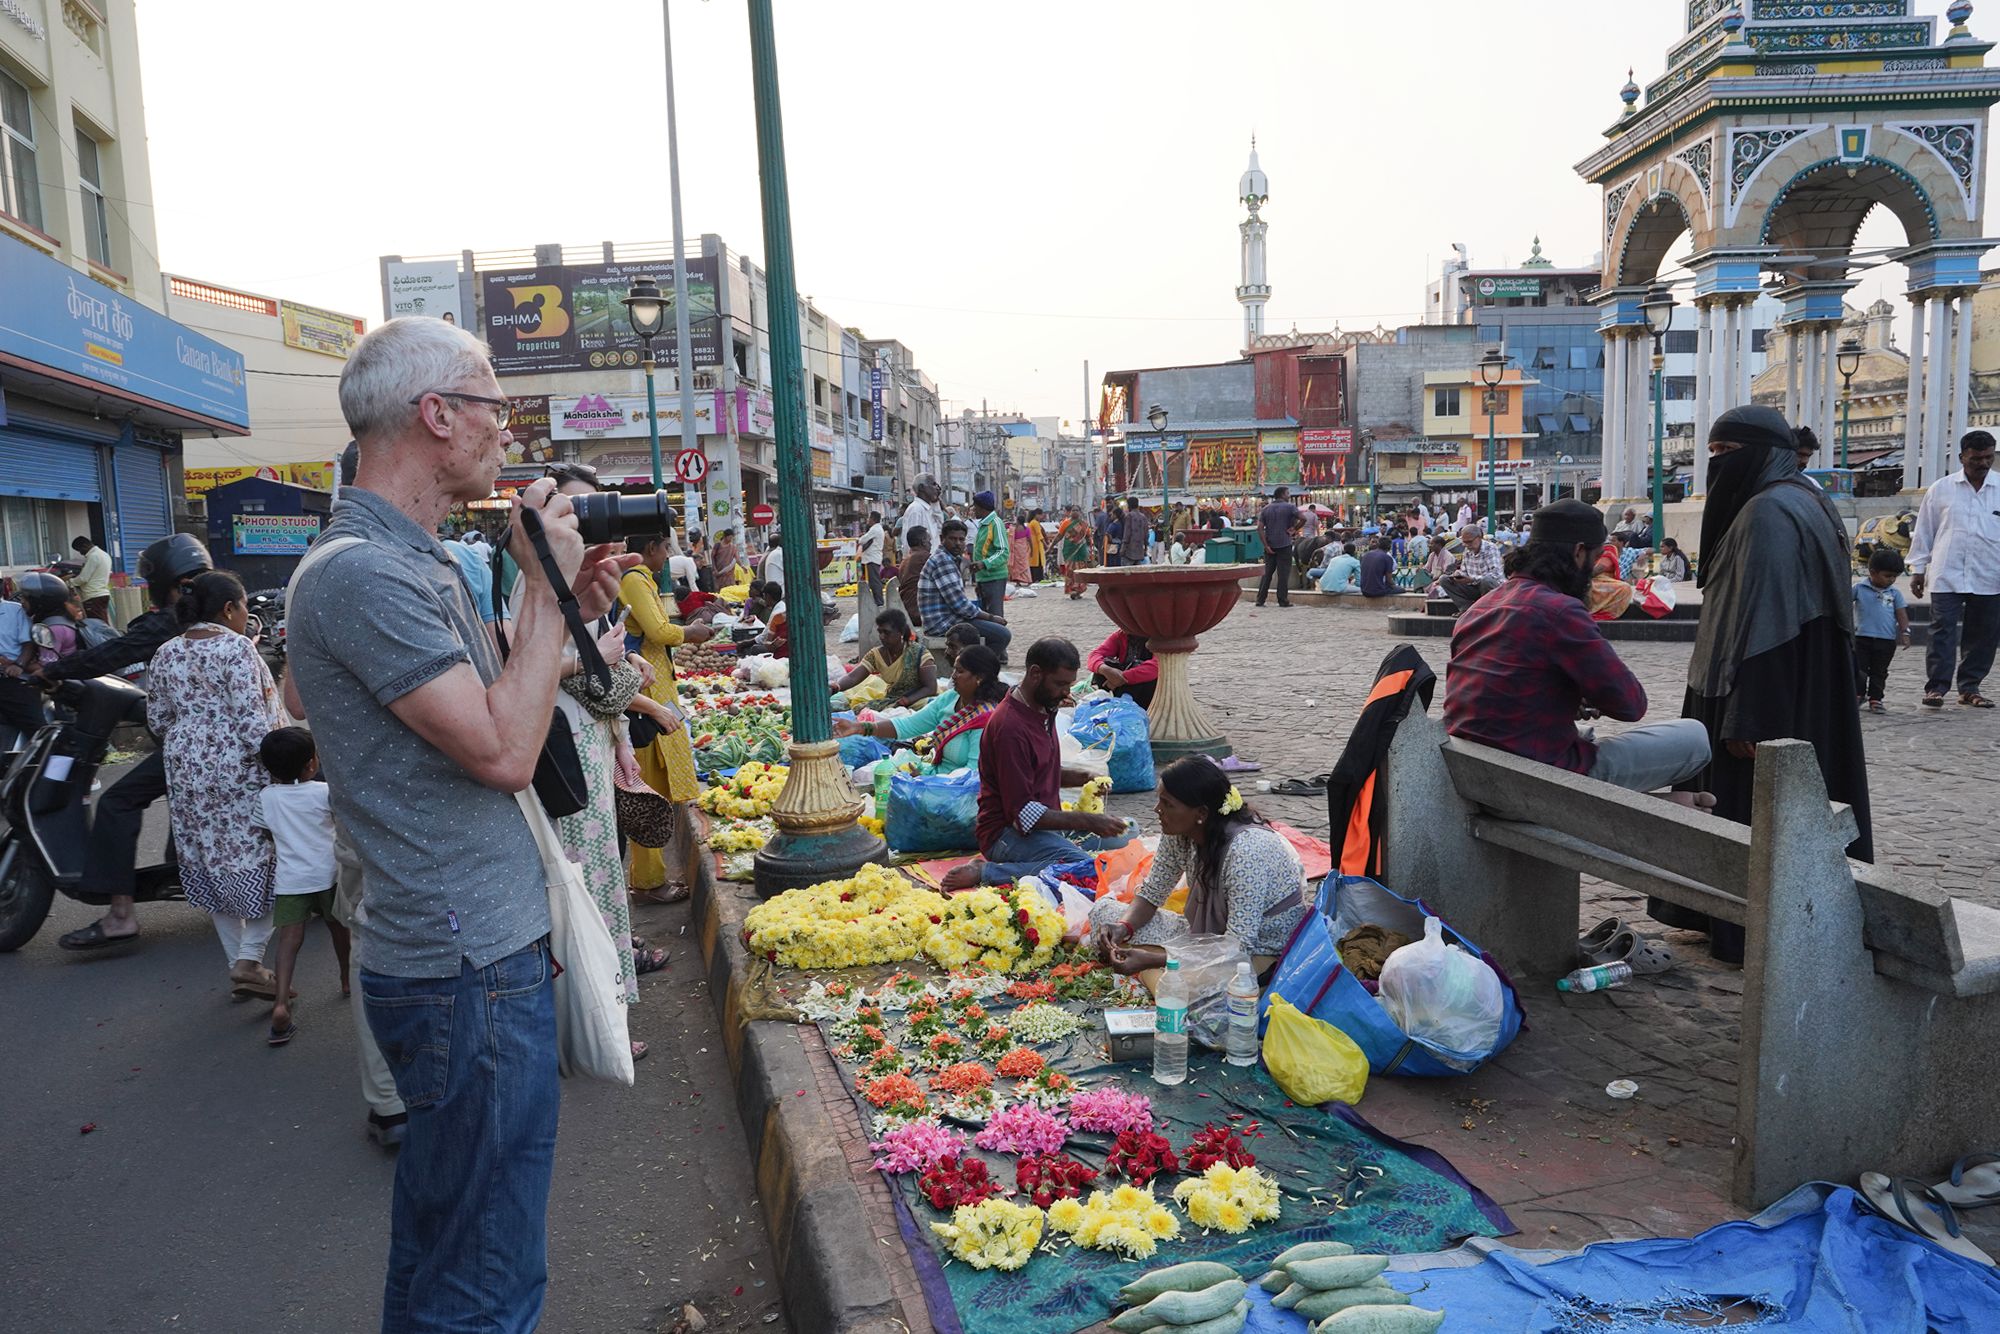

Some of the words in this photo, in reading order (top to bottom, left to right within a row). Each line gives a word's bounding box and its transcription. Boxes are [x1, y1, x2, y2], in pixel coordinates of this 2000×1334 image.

[492, 314, 542, 326] BHIMA
[517, 341, 560, 351] Properties
[177, 335, 212, 374] Canara
[211, 350, 233, 383] Bank
[563, 409, 623, 420] Mahalakshmi
[245, 517, 278, 526] PHOTO
[281, 518, 317, 527] STUDIO
